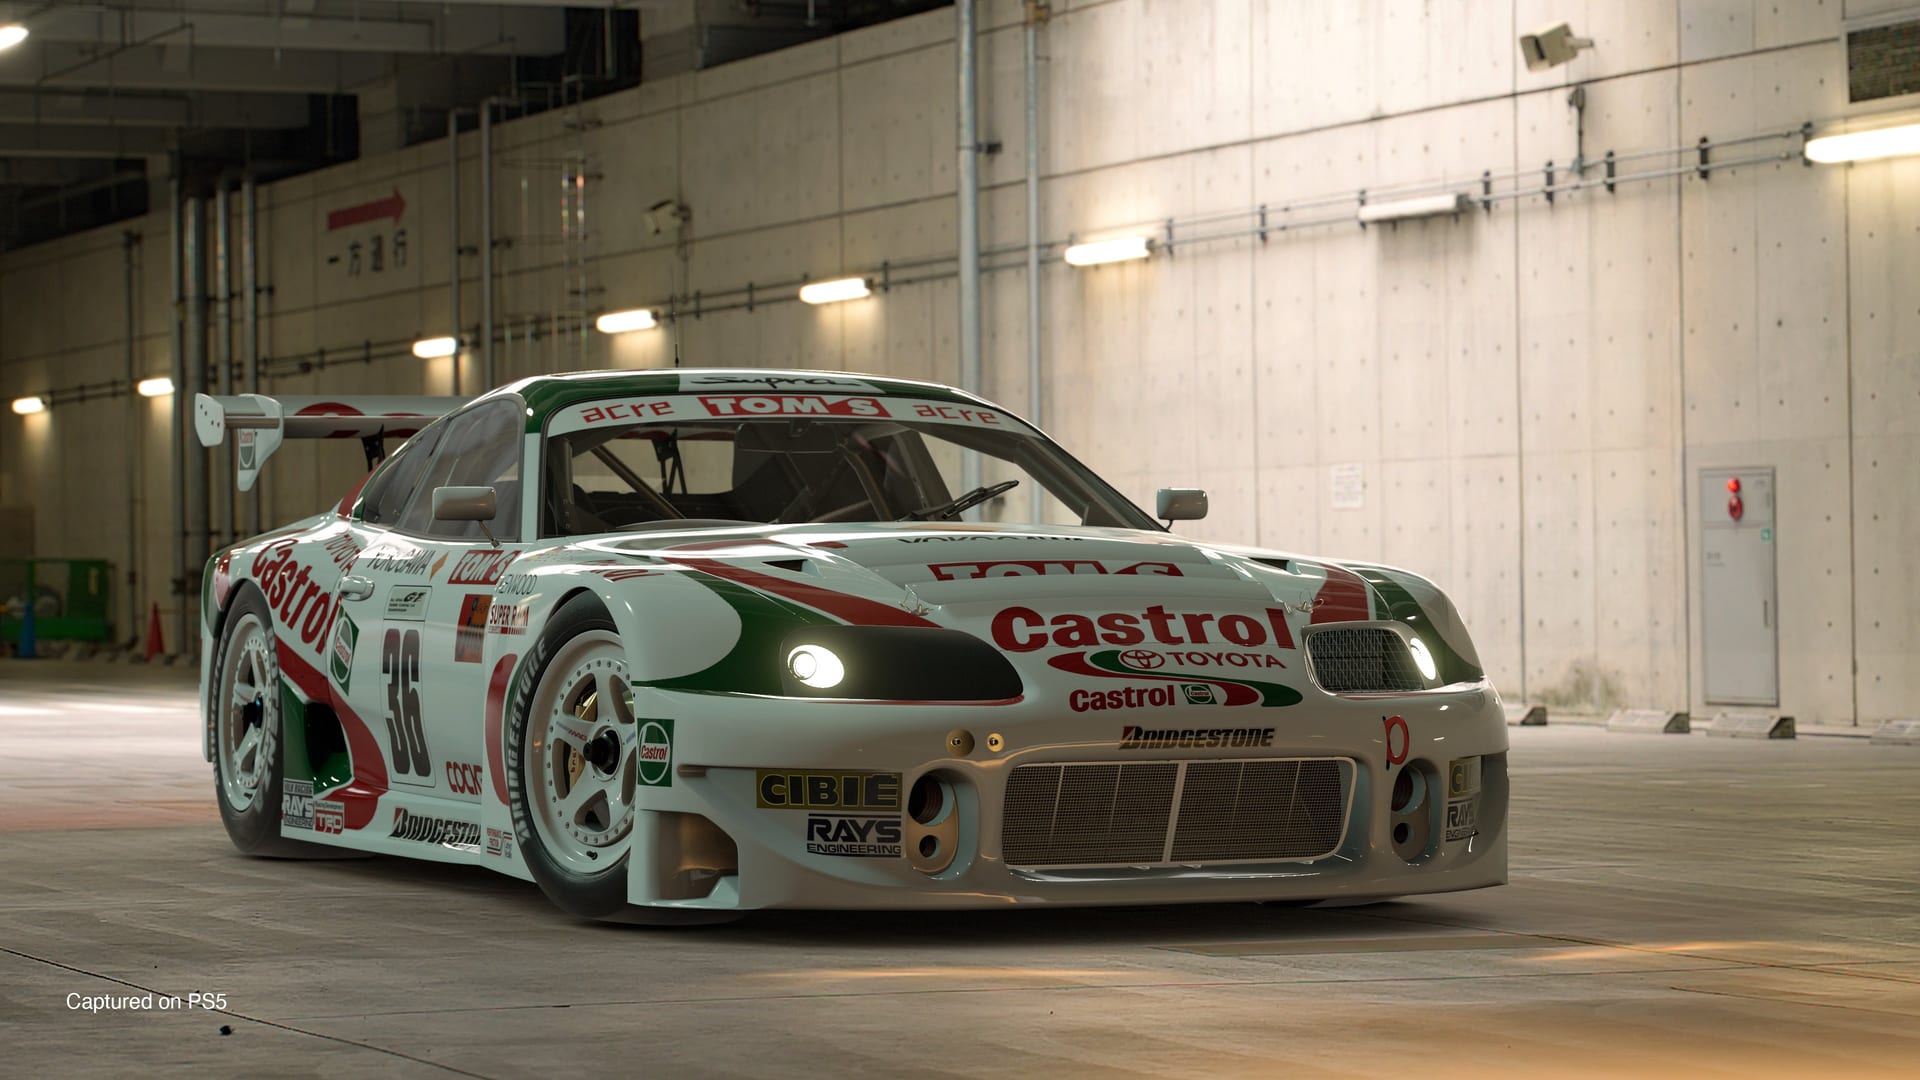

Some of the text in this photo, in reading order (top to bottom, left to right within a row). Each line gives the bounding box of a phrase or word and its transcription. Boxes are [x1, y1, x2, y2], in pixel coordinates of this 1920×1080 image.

[691, 376, 852, 389] Supra
[580, 401, 675, 423] acre
[912, 404, 1001, 424] acre
[252, 538, 342, 655] Castrol
[991, 604, 1297, 653] Castrol
[1165, 651, 1288, 669] TOYOTA
[382, 628, 431, 778] 36
[1069, 684, 1176, 713] Castrol
[1118, 725, 1276, 751] BRIDGESTONE
[641, 744, 669, 760] Castrol
[282, 795, 314, 818] RAYS
[387, 806, 481, 846] BRIDGESTO
[807, 818, 902, 843] RAYS
[806, 843, 902, 855] ENGINEERING
